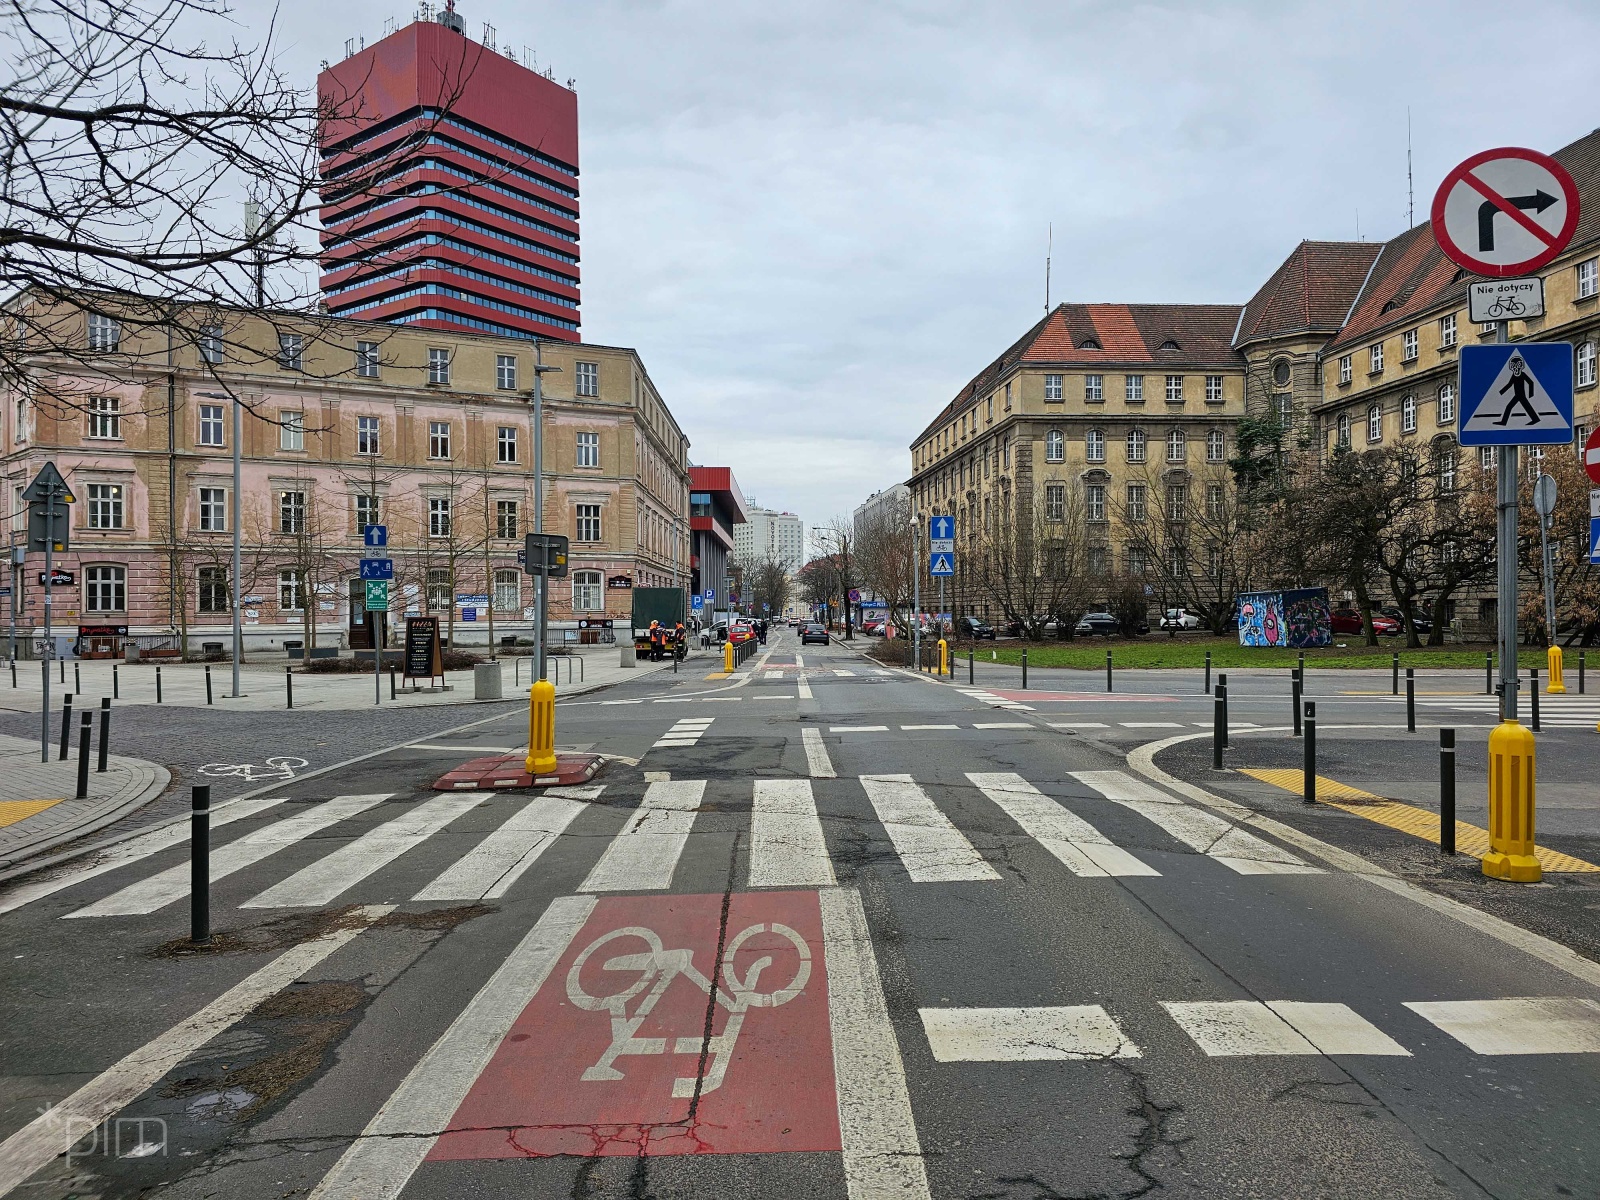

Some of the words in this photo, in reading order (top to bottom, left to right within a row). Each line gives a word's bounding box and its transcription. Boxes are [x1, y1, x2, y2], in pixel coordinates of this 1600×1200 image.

[1477, 286, 1494, 295] Nie
[1497, 283, 1534, 293] dotyczy
[706, 590, 713, 598] P
[694, 596, 701, 606] P
